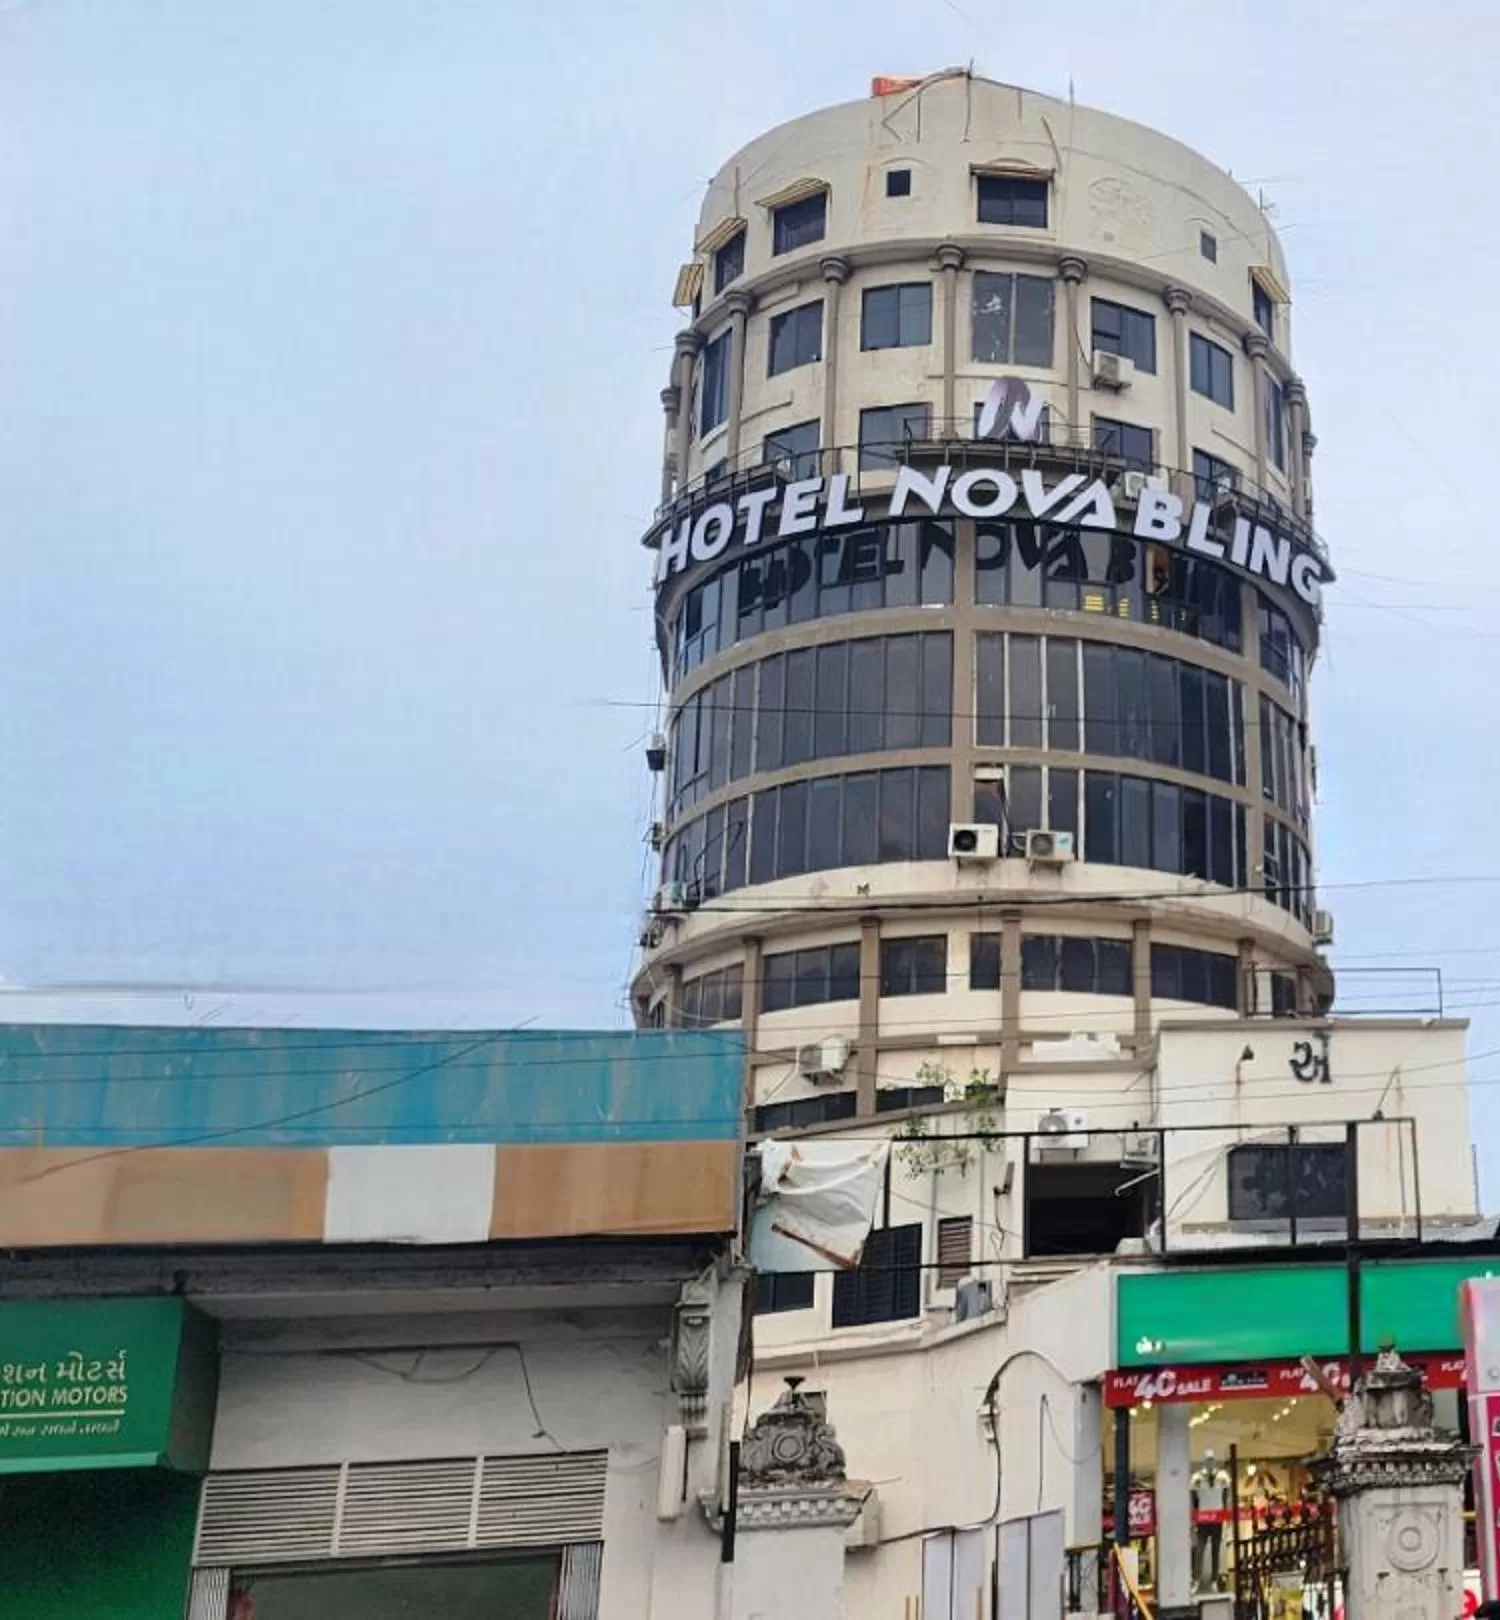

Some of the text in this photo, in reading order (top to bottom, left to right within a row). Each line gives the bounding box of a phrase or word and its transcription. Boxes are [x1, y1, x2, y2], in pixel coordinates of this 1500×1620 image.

[656, 474, 864, 583] HOTEL
[888, 465, 1117, 528] NOVA
[1134, 486, 1326, 605] BLING
[52, 1384, 128, 1405] MOTORS
